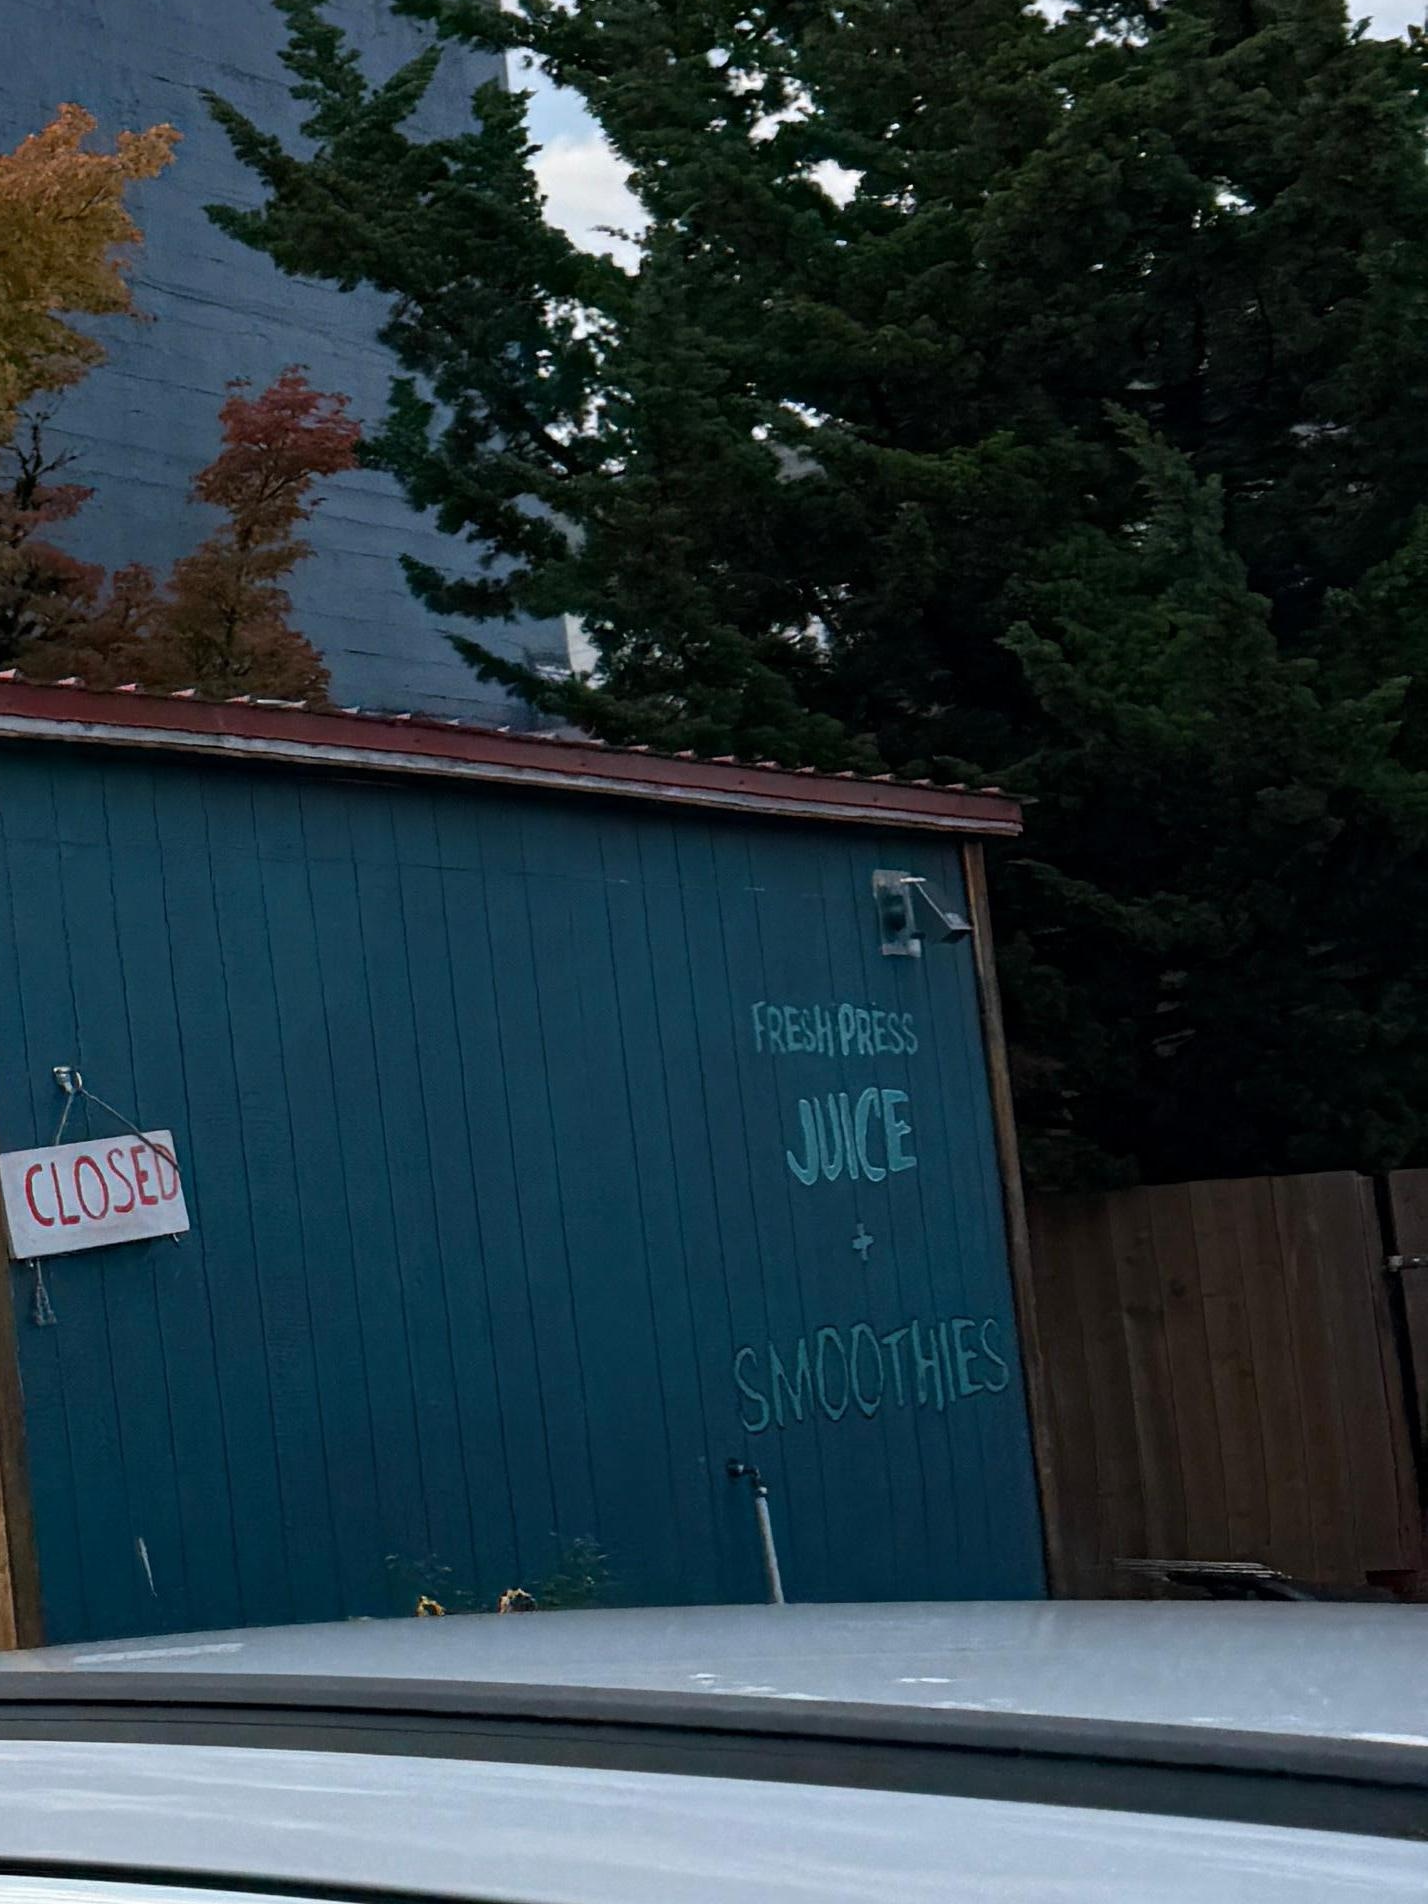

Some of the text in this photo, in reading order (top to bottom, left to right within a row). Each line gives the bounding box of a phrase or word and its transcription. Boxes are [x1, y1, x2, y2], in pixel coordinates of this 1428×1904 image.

[751, 1001, 918, 1057] FRESH PRESS
[786, 1087, 918, 1186] JUICE
[24, 1143, 181, 1227] CLOSED
[734, 1316, 1009, 1435] SMOOTHIES
